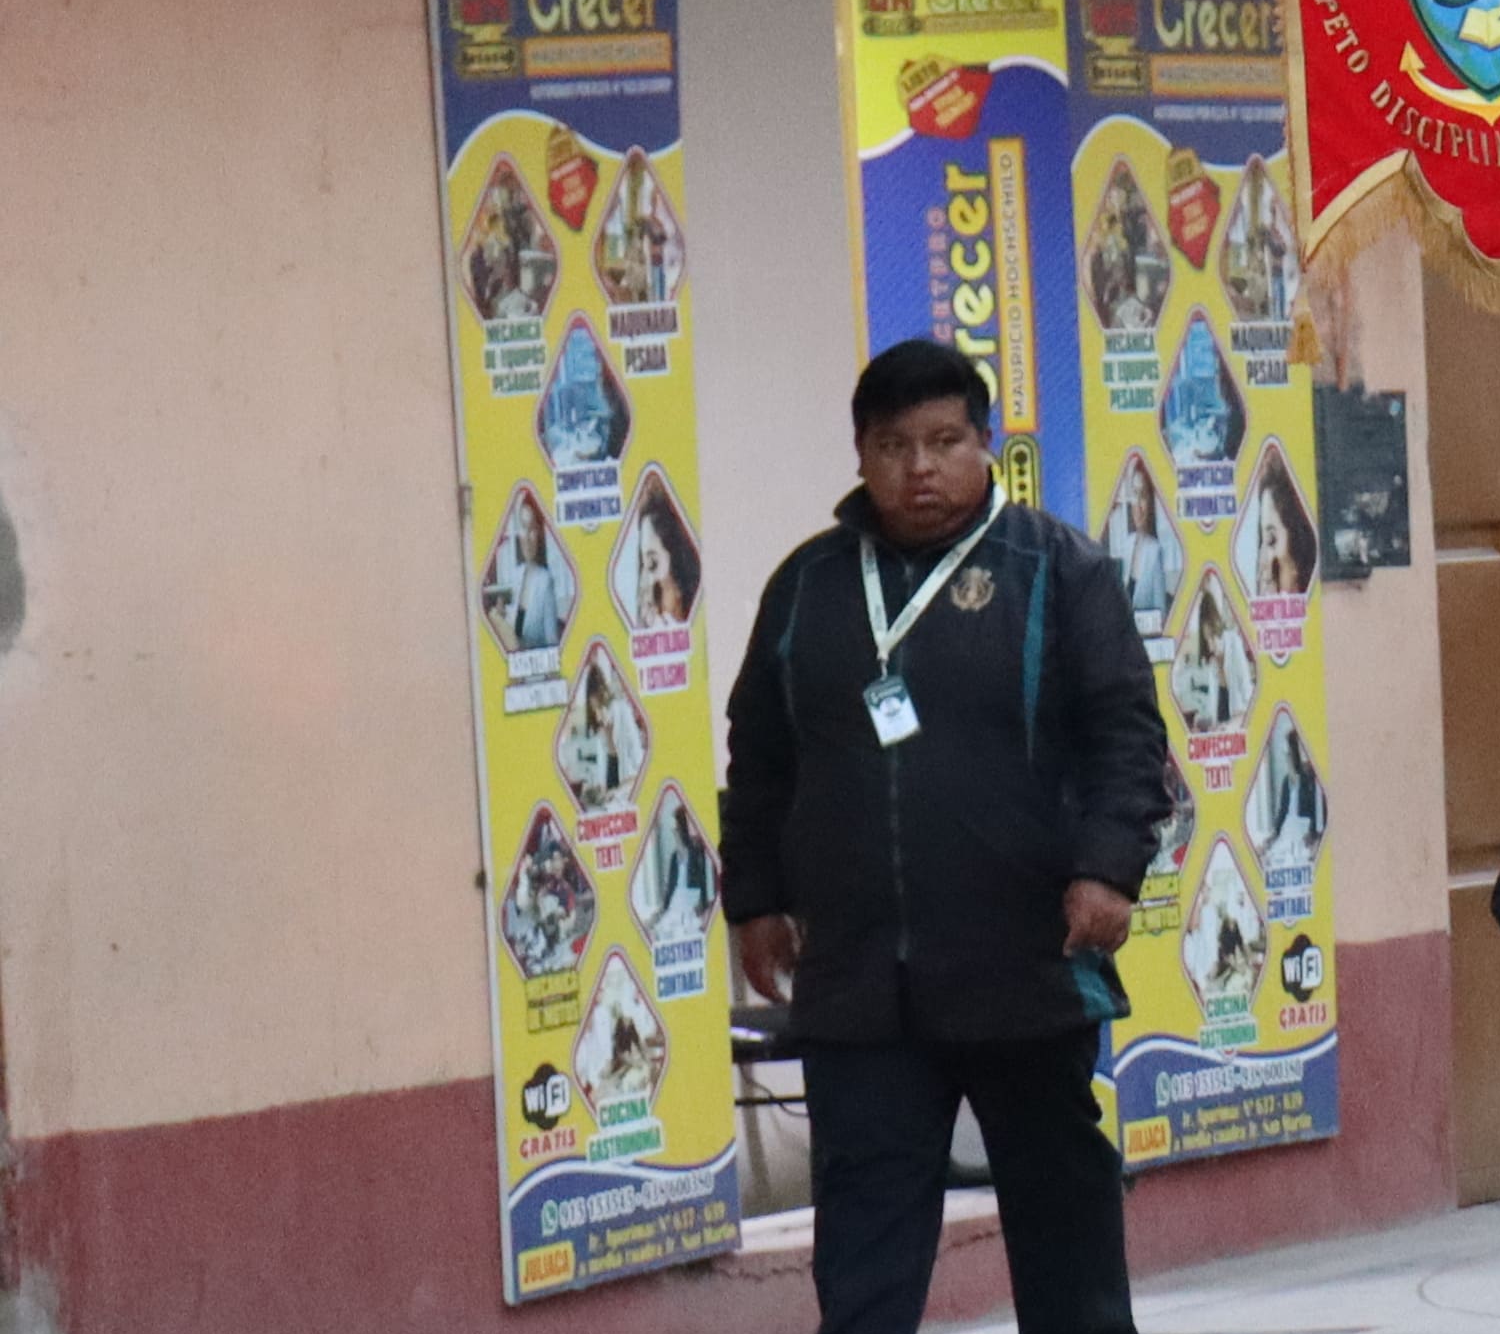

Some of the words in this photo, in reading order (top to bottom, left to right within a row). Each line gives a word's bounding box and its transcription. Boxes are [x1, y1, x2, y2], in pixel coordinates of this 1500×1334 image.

[1000, 153, 1020, 300] HOCHSCHILD
[1231, 326, 1291, 352] MAQUINAR
[1005, 309, 1026, 417] MAURICIO
[1279, 1004, 1327, 1029] GRATIS
[520, 1129, 576, 1158] GRATIS
